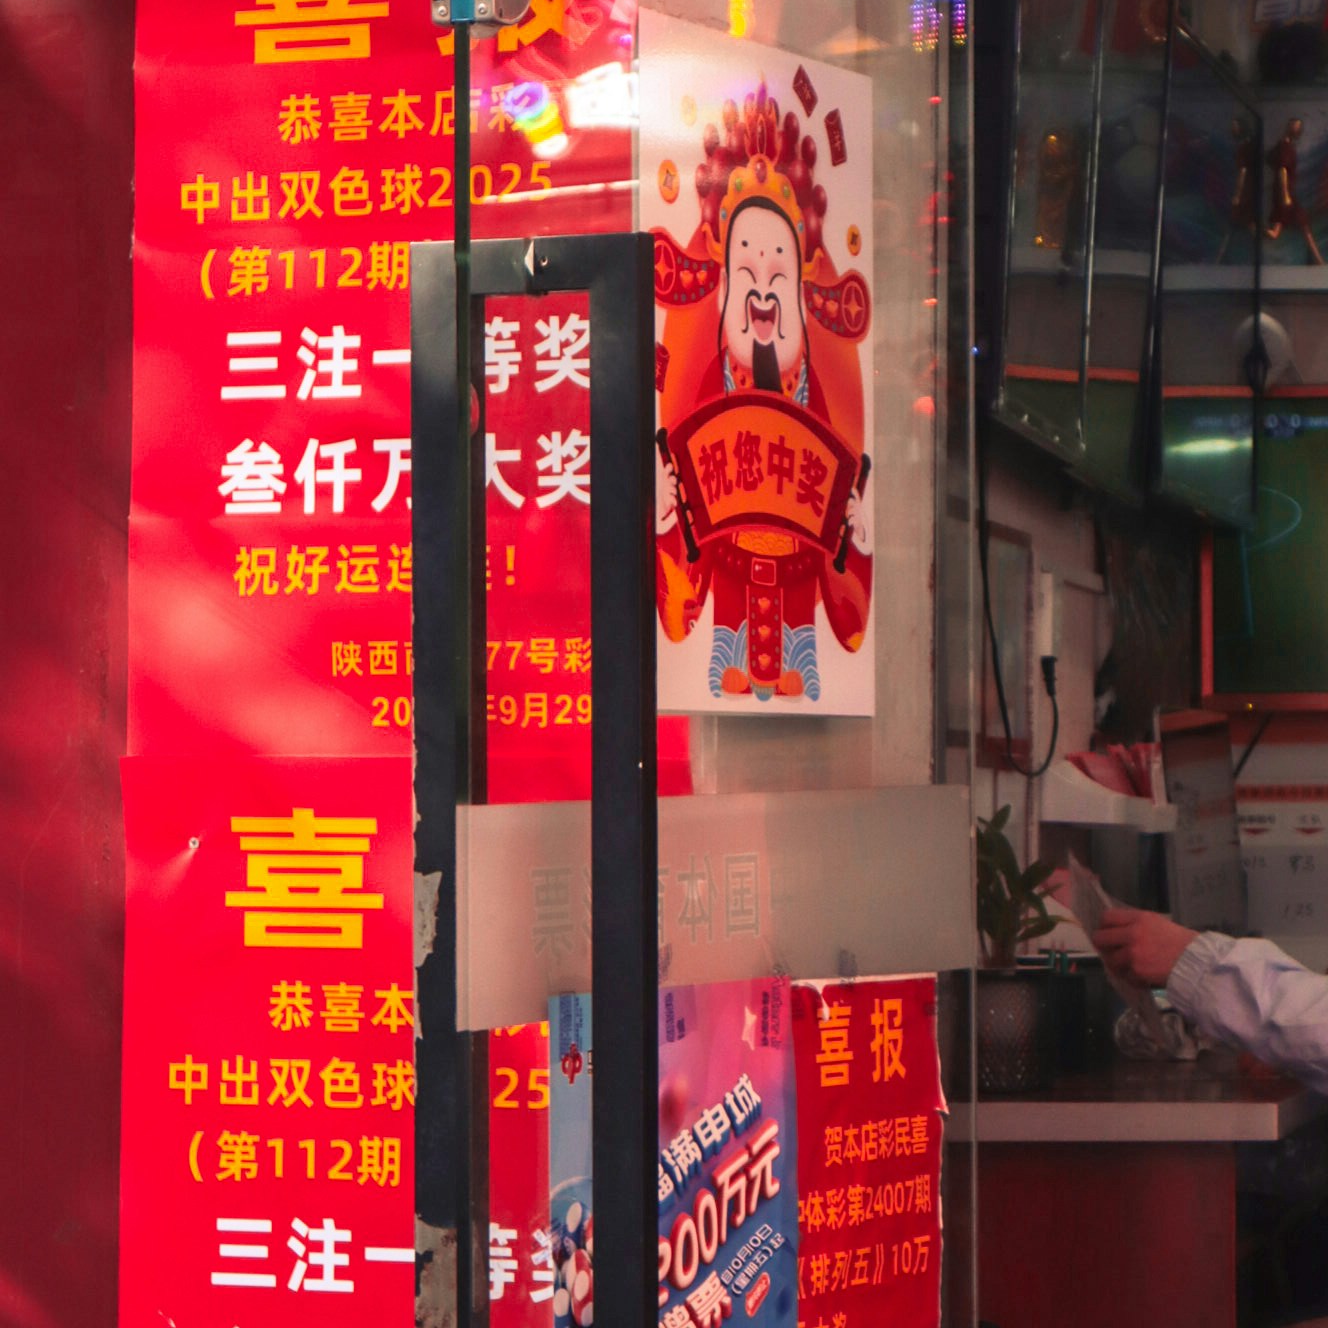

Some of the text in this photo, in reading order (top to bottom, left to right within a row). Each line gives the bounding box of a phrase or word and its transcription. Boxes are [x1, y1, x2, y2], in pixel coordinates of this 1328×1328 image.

[179, 159, 553, 226] 中出双色球2025
[697, 428, 831, 519] 祝您中奖
[816, 998, 907, 1088] 喜报
[825, 1115, 930, 1167] 贺本店彩民喜
